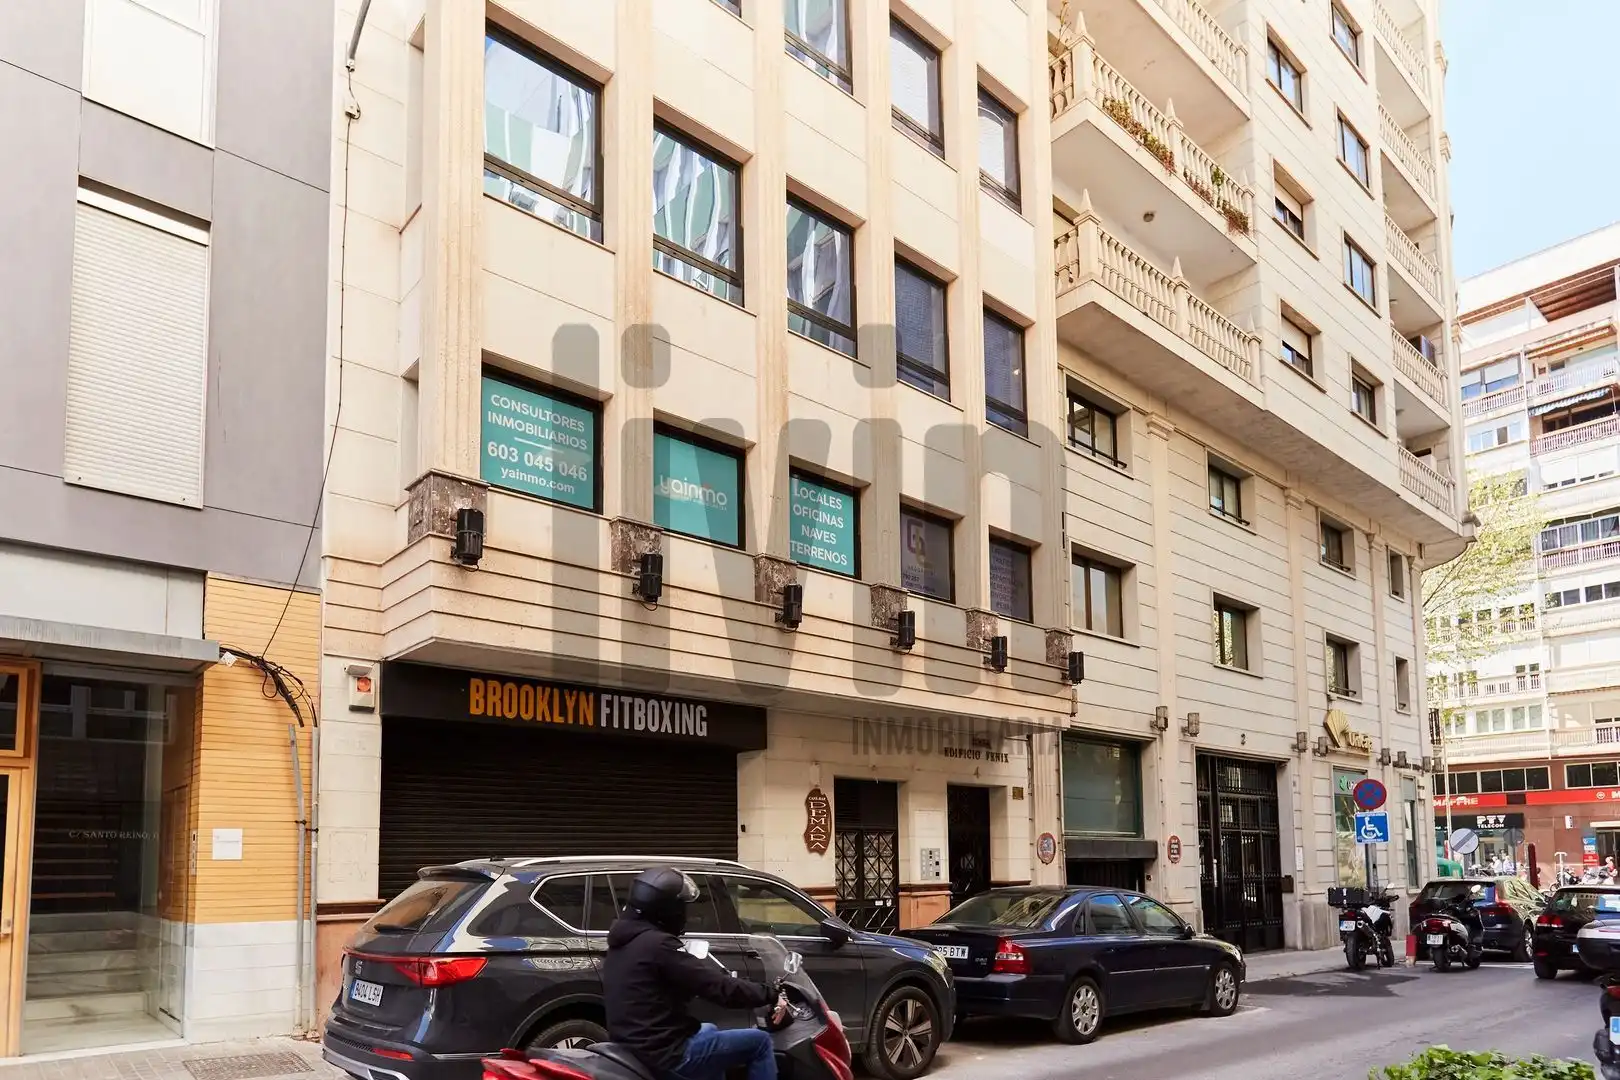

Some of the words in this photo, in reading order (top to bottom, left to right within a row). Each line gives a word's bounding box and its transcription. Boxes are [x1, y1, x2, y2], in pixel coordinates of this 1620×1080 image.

[491, 394, 585, 432] CONSULTORES
[488, 411, 587, 450] INMOBILIARIOS
[487, 441, 518, 462] 603
[524, 451, 553, 472] 045
[559, 461, 587, 481] 046
[500, 467, 575, 494] yainmo.com
[660, 474, 727, 506] yainmo
[794, 484, 842, 509] LOCALES
[793, 504, 844, 528] OFICINAS
[801, 524, 837, 544] NAVES
[789, 540, 848, 565] TERRENOS
[469, 677, 595, 727] BROOKLYN
[600, 693, 707, 737] FITBOXING
[944, 747, 981, 760] EDIFICIO
[1477, 815, 1506, 824] PTV
[84, 831, 117, 839] SANTO
